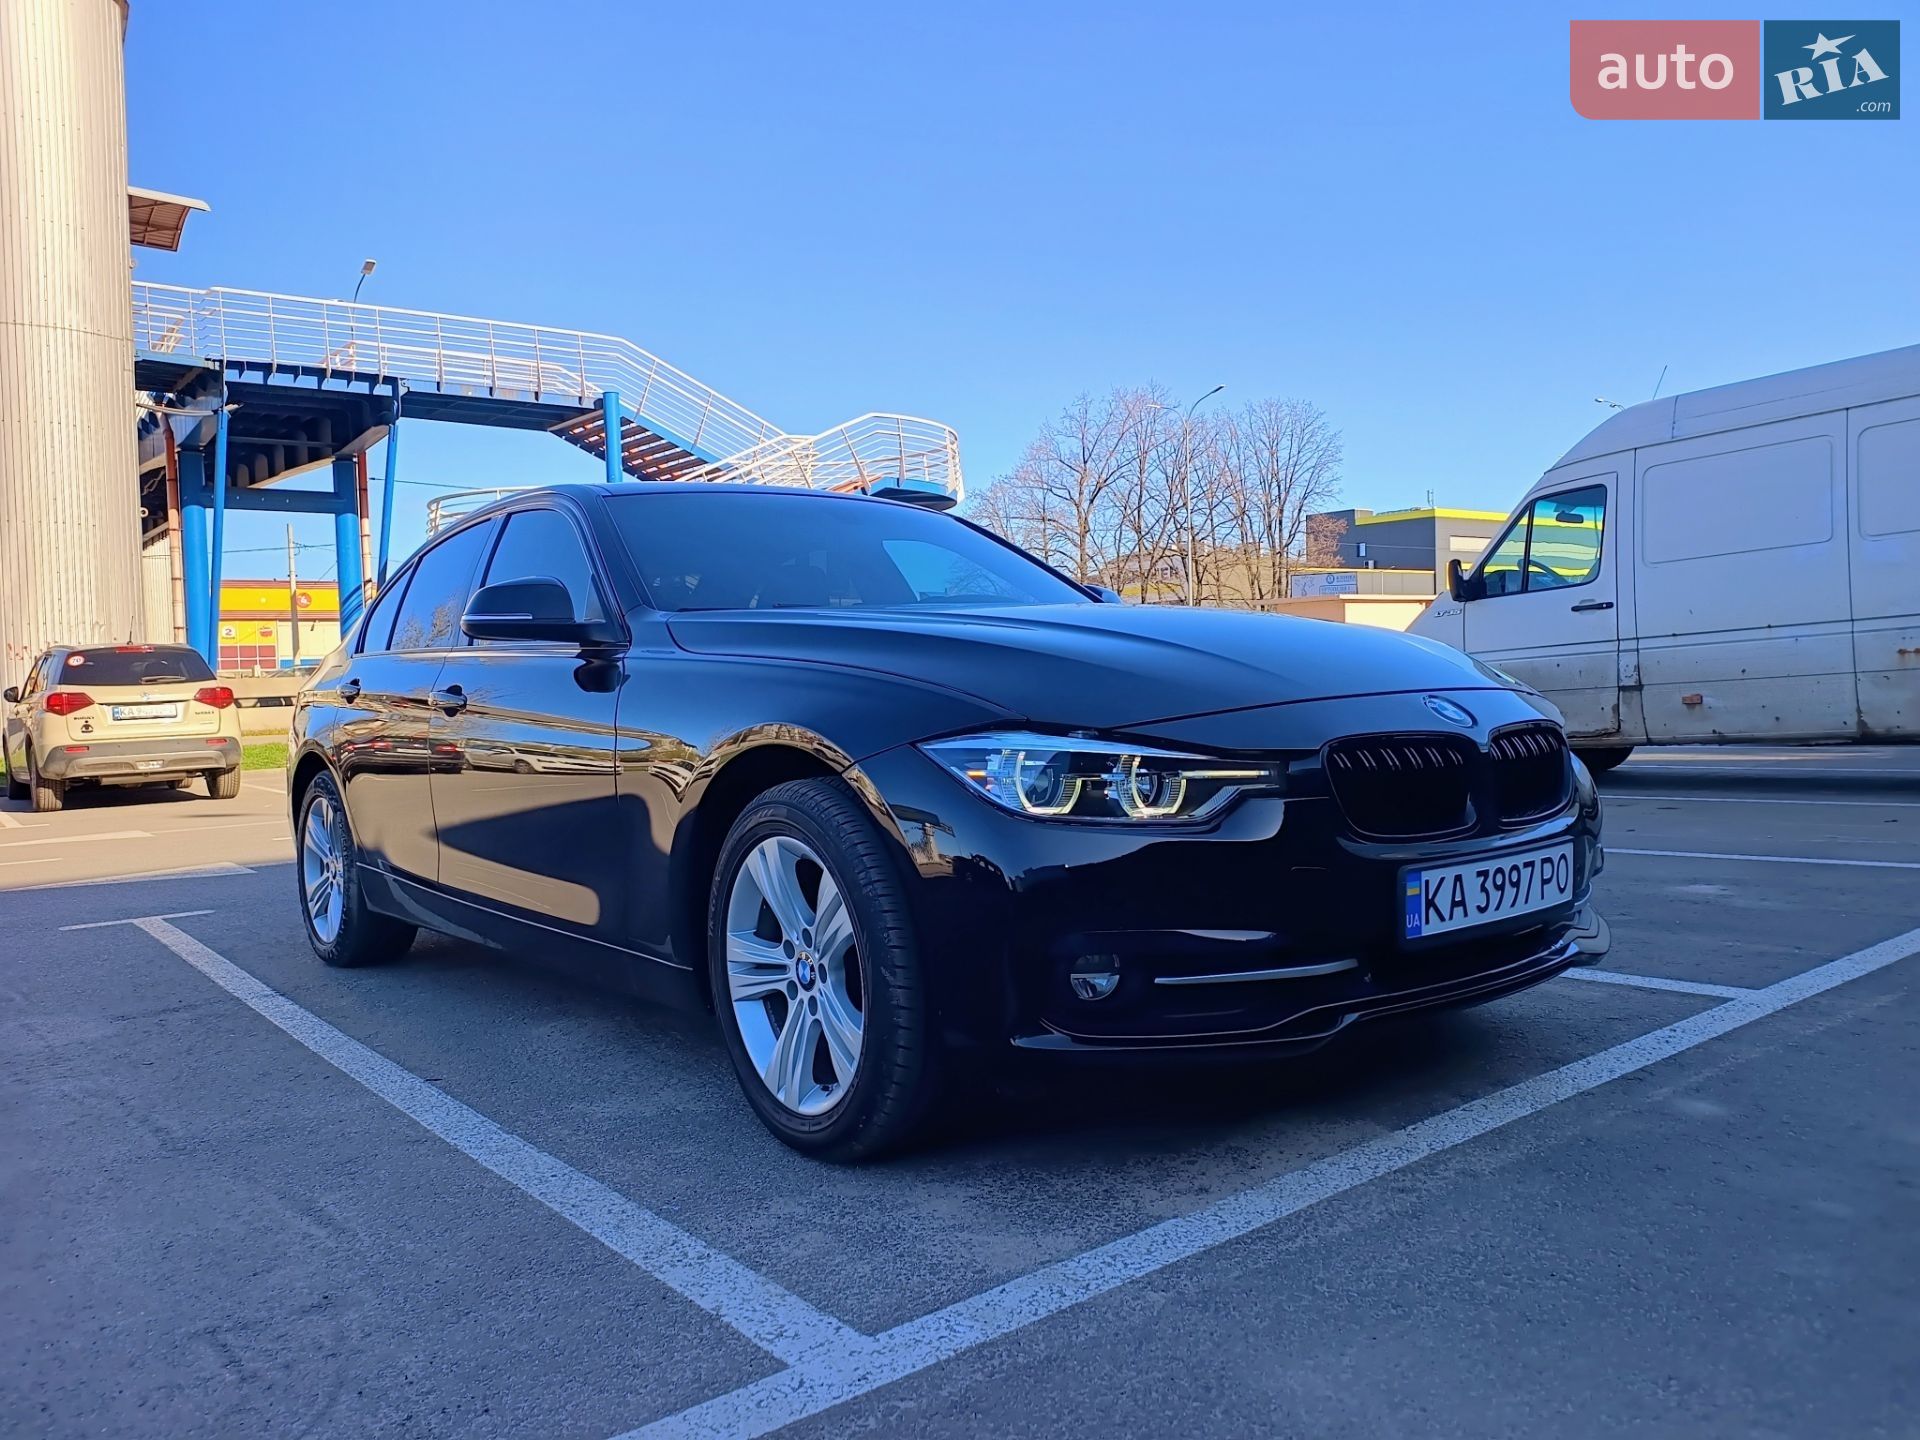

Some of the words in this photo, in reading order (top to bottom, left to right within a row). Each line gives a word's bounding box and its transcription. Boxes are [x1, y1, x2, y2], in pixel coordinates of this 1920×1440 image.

[1424, 873, 1469, 925] KA
[1475, 860, 1536, 914] 3997
[1540, 852, 1569, 900] PO
[1406, 913, 1421, 928] UA
